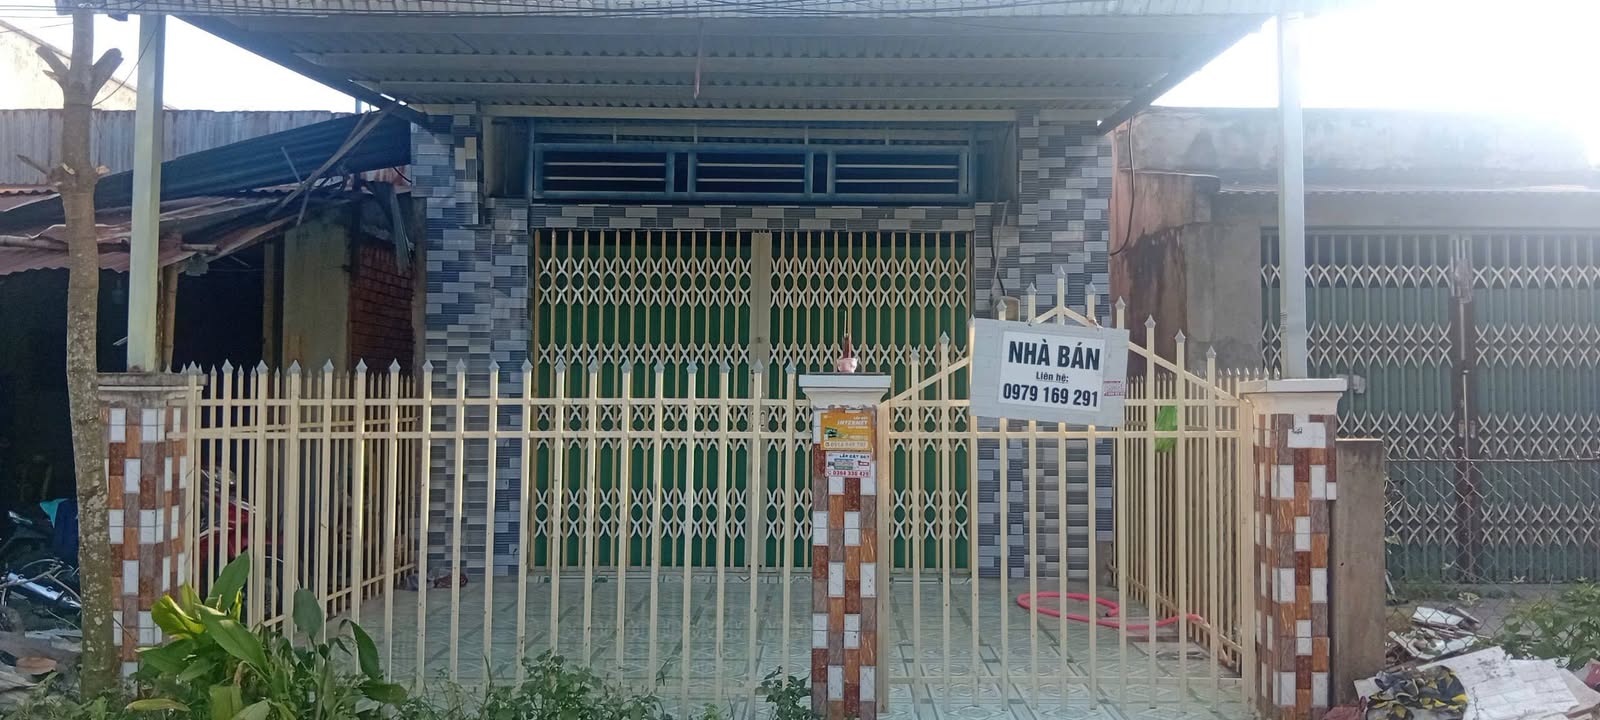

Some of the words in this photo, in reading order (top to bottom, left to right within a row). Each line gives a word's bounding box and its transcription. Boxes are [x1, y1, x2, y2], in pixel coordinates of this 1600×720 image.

[1008, 338, 1050, 367] NHÀ
[1057, 342, 1100, 371] BÁN
[1036, 371, 1053, 381] Liên
[1056, 372, 1069, 383] hệ:
[1003, 383, 1038, 402] 0979
[1043, 387, 1069, 405] 169
[1073, 389, 1098, 407] 291
